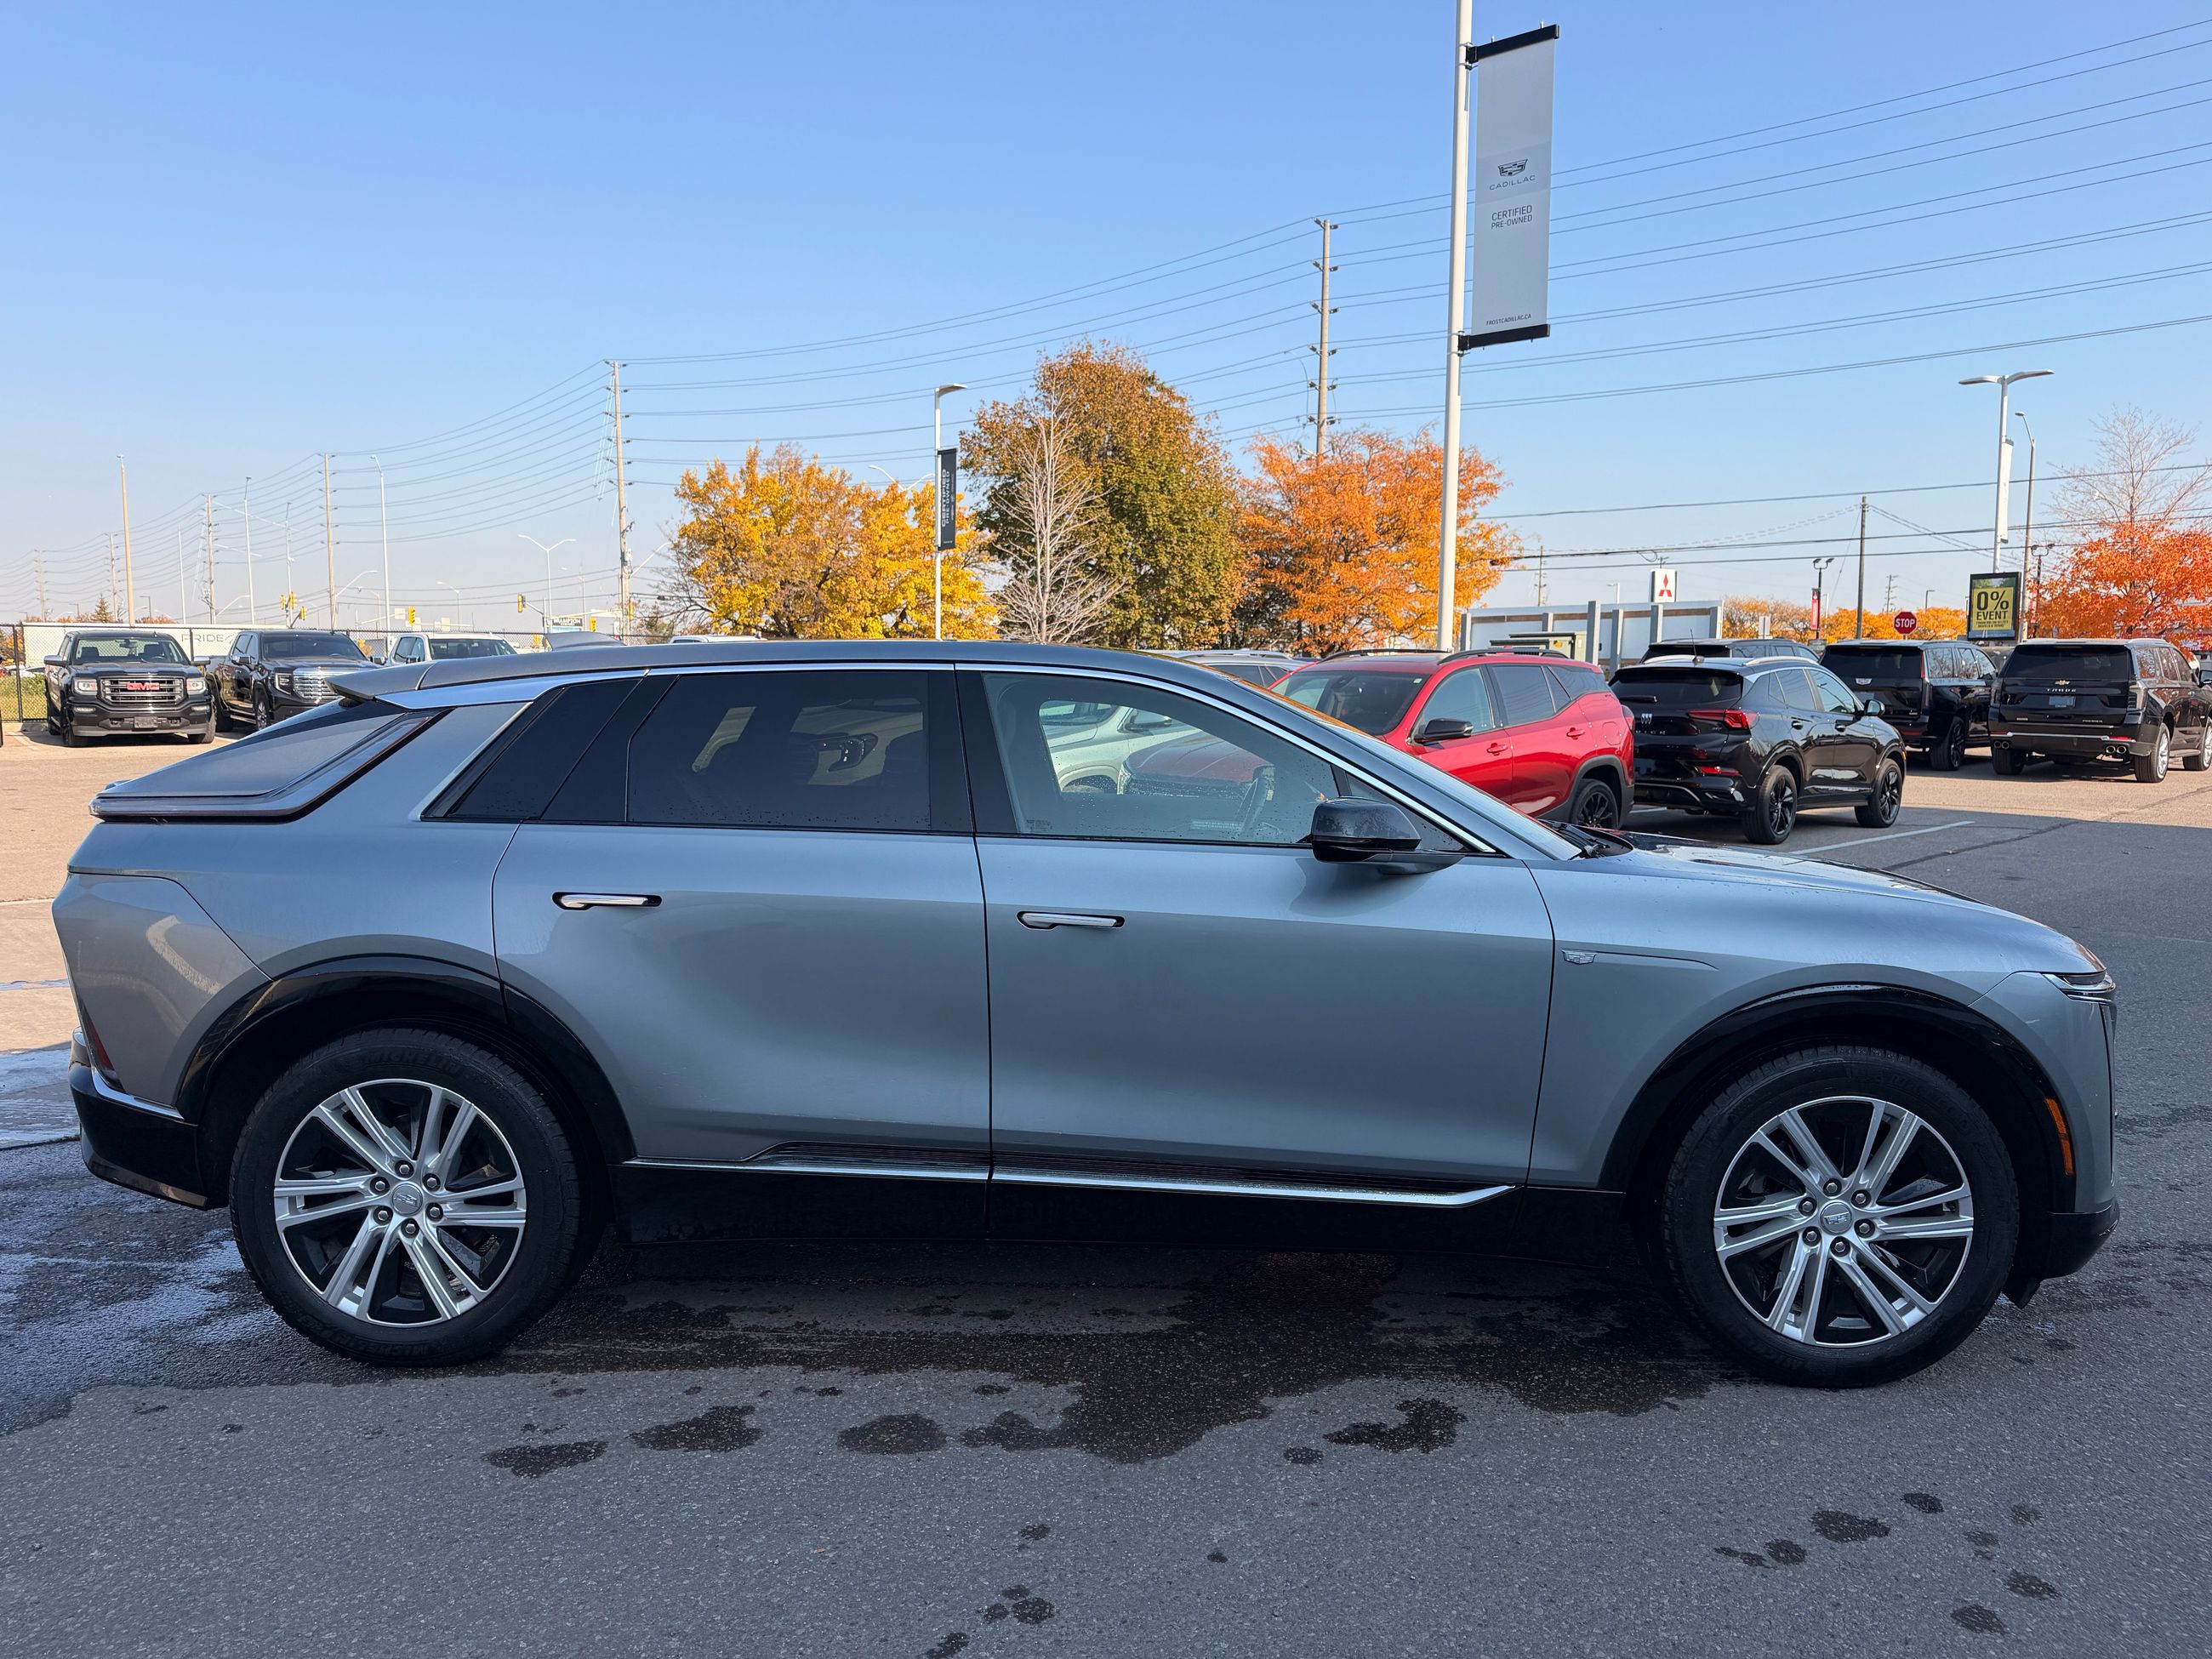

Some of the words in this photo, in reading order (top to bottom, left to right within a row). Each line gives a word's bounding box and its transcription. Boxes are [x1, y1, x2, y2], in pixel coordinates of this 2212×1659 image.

[1489, 174, 1536, 191] CADILLAC
[1491, 205, 1532, 221] CERTIFIED
[1491, 214, 1532, 230] PRE-OWNED
[1976, 590, 2010, 611] 0%
[1895, 618, 1916, 628] STOP
[1976, 610, 2009, 621] EVENT
[181, 634, 225, 642] PRIDE
[126, 682, 160, 691] GMC
[365, 1050, 464, 1074] MICHELIN
